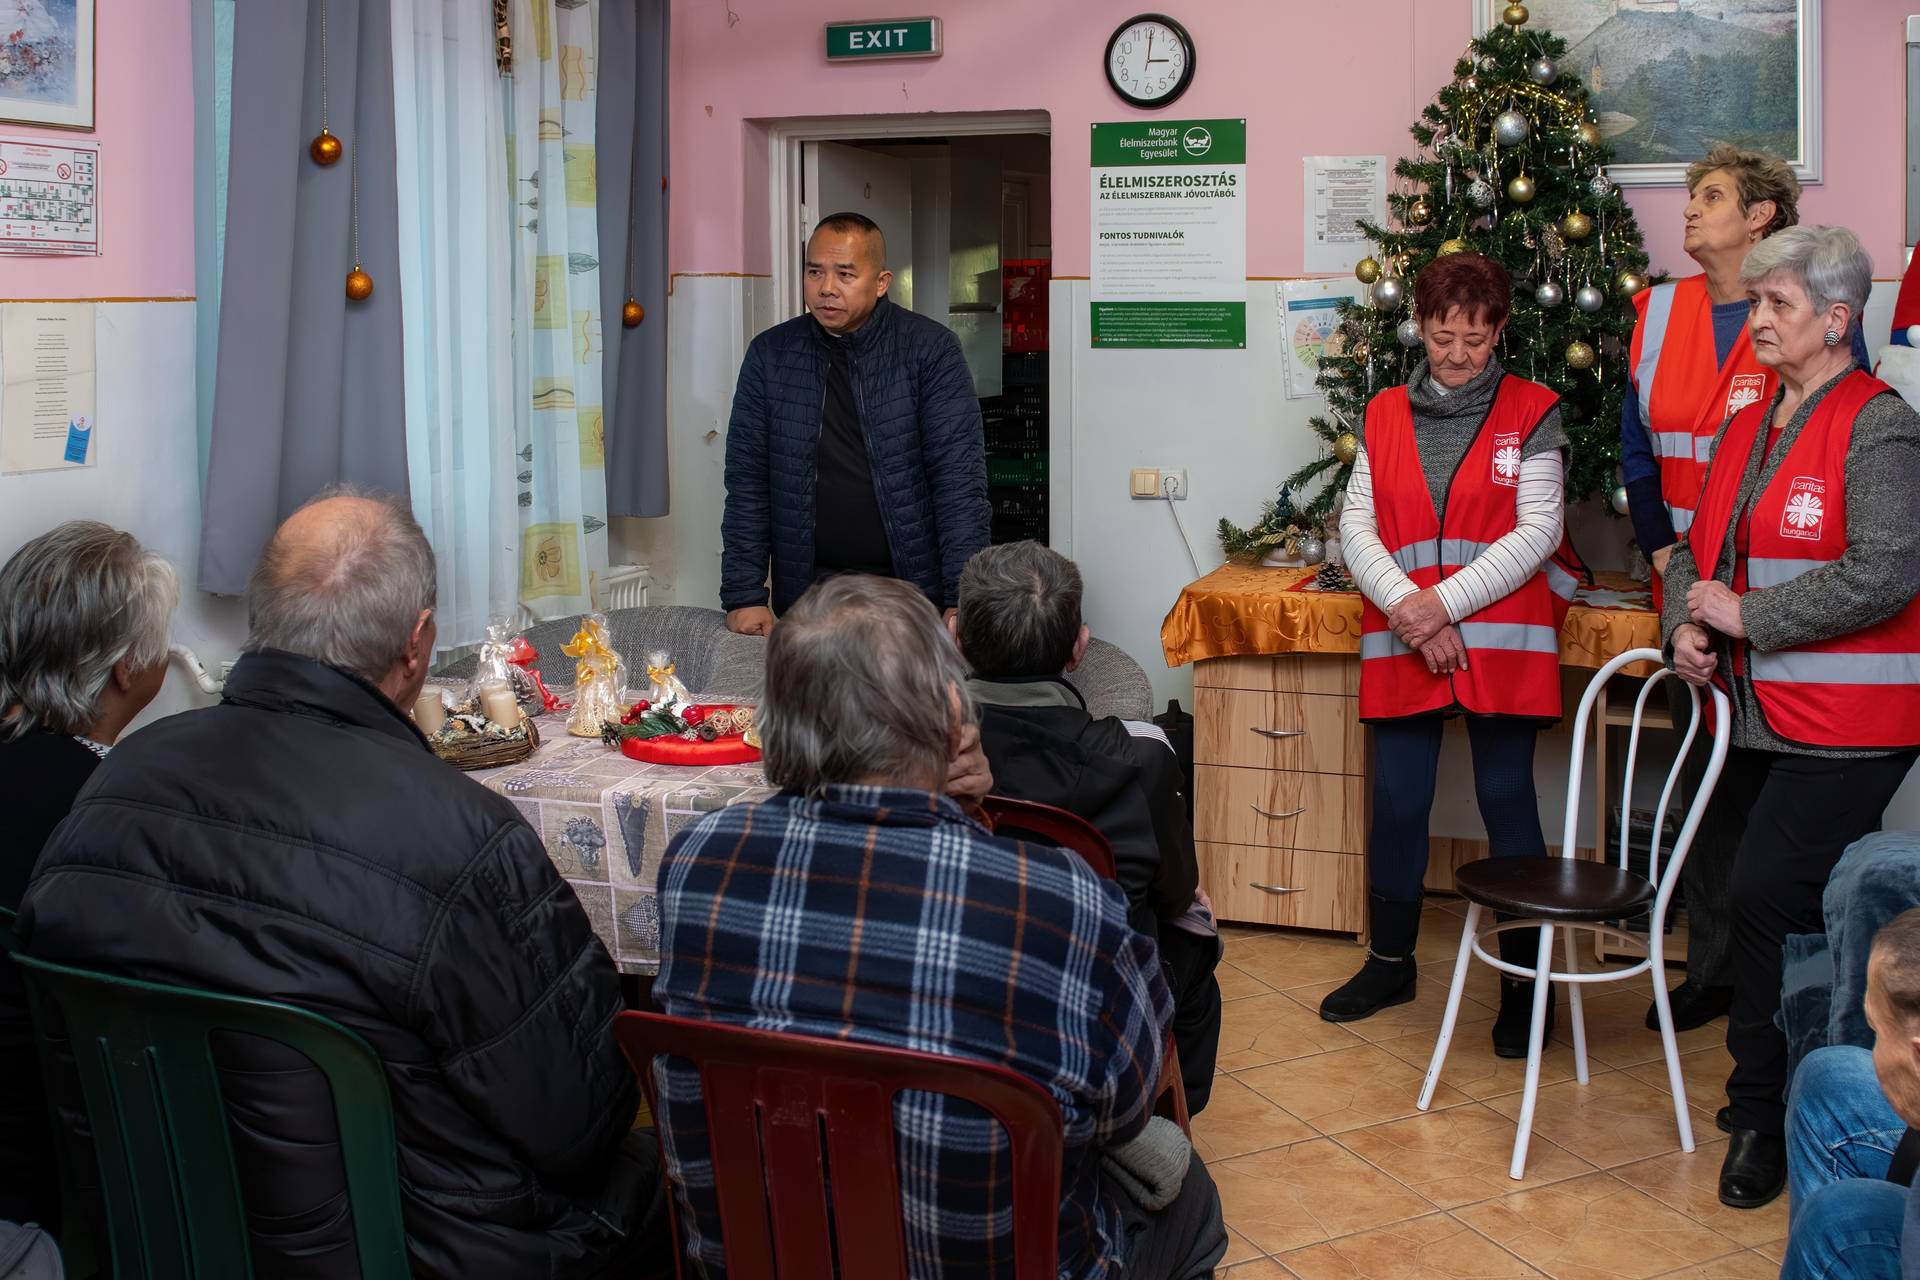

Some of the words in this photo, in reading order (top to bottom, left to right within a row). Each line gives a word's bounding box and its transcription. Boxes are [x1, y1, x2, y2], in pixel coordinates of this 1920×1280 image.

[849, 28, 908, 49] EXIT
[1133, 30, 1141, 41] 11
[1143, 26, 1155, 40] 12
[1161, 30, 1166, 42] 1
[1120, 41, 1132, 55] 10
[1168, 38, 1178, 51] 2
[1117, 55, 1126, 67] 9
[1173, 53, 1182, 67] 3
[1120, 68, 1128, 81] 8
[1168, 69, 1176, 81] 4
[1132, 80, 1139, 91] 7
[1145, 82, 1153, 94] 6
[1159, 77, 1167, 90] 5
[1149, 127, 1178, 138] Magyar
[1120, 137, 1178, 148] Élelmiszerbank
[1140, 148, 1178, 159] Egyesület
[1099, 171, 1237, 189] ÉLELMISZEROSZTÁS
[1100, 192, 1110, 200] AZ
[1112, 189, 1182, 200] ÉLELMISZERBANK
[1184, 188, 1236, 199] JÓVOLTÁBÓL
[1099, 232, 1131, 240] FONTOS
[1133, 230, 1184, 240] TUDNIVALÓK
[1734, 377, 1761, 387] caritas
[1793, 480, 1826, 494] caritas
[1782, 526, 1818, 537] hungarica
